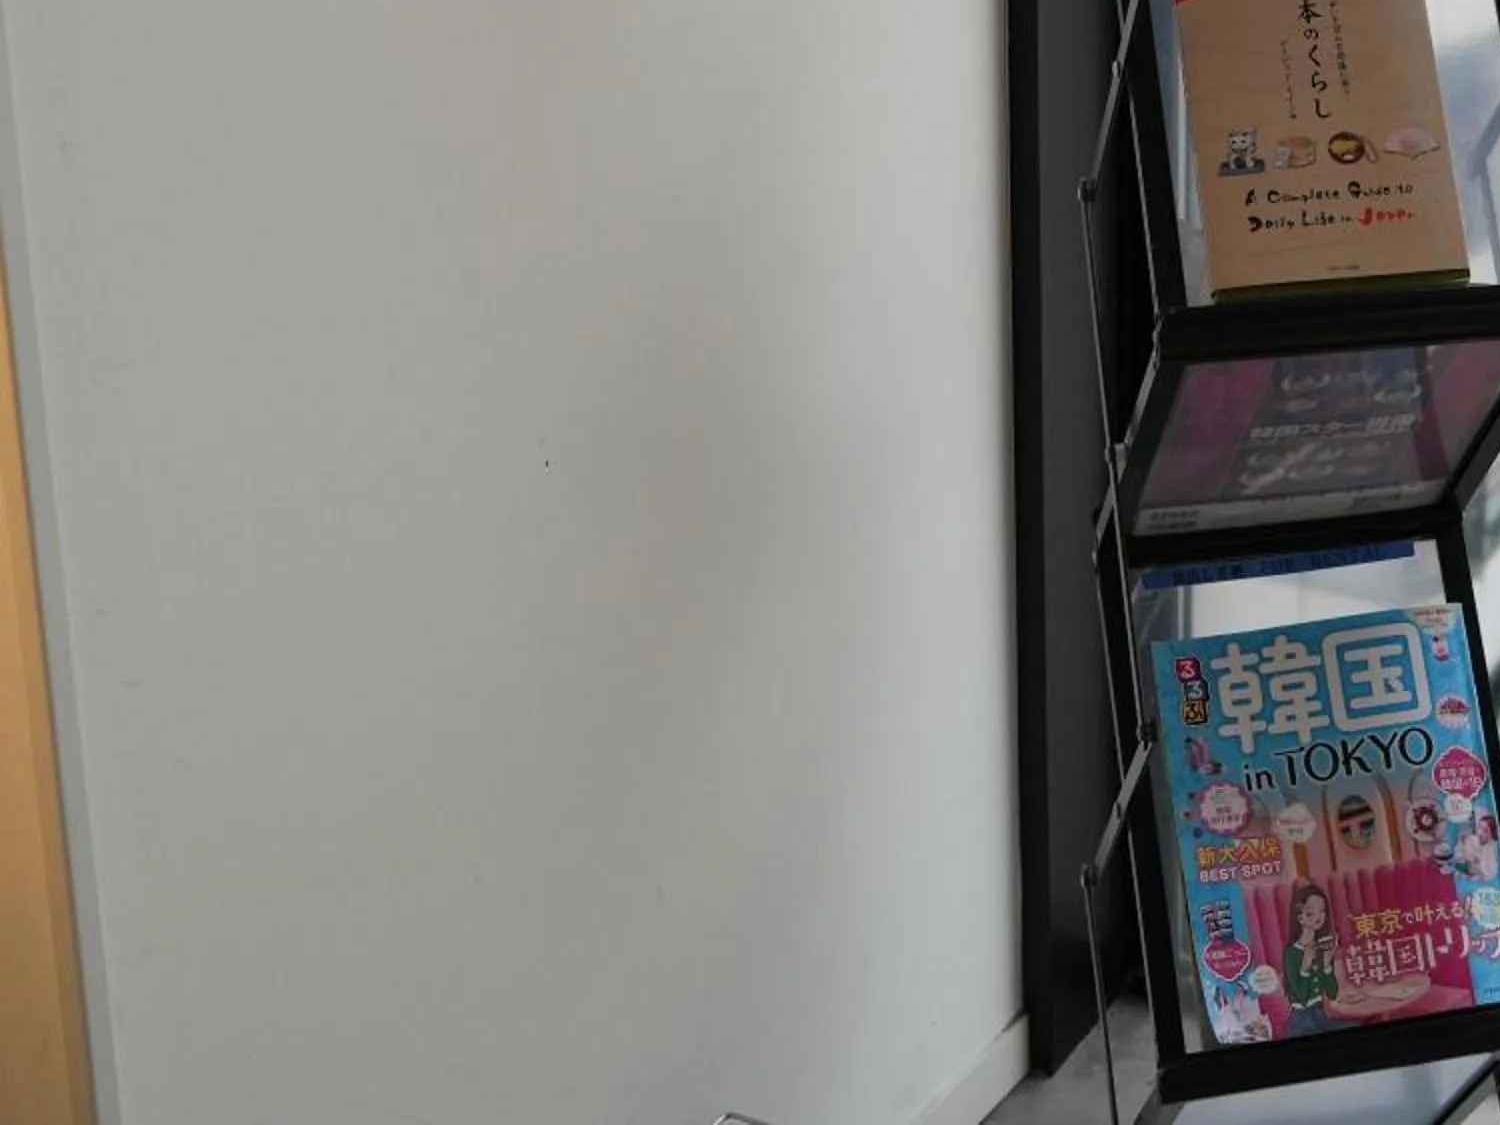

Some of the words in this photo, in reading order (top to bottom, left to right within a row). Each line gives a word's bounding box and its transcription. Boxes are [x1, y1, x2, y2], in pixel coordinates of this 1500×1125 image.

[1176, 657, 1210, 725] るるぶ
[1212, 622, 1433, 755] 韓国
[1243, 762, 1275, 792] in
[1273, 727, 1434, 786] TOKYO
[1197, 836, 1282, 867] 新大久保
[1199, 866, 1238, 883] BEST
[1241, 860, 1282, 879] SPOT
